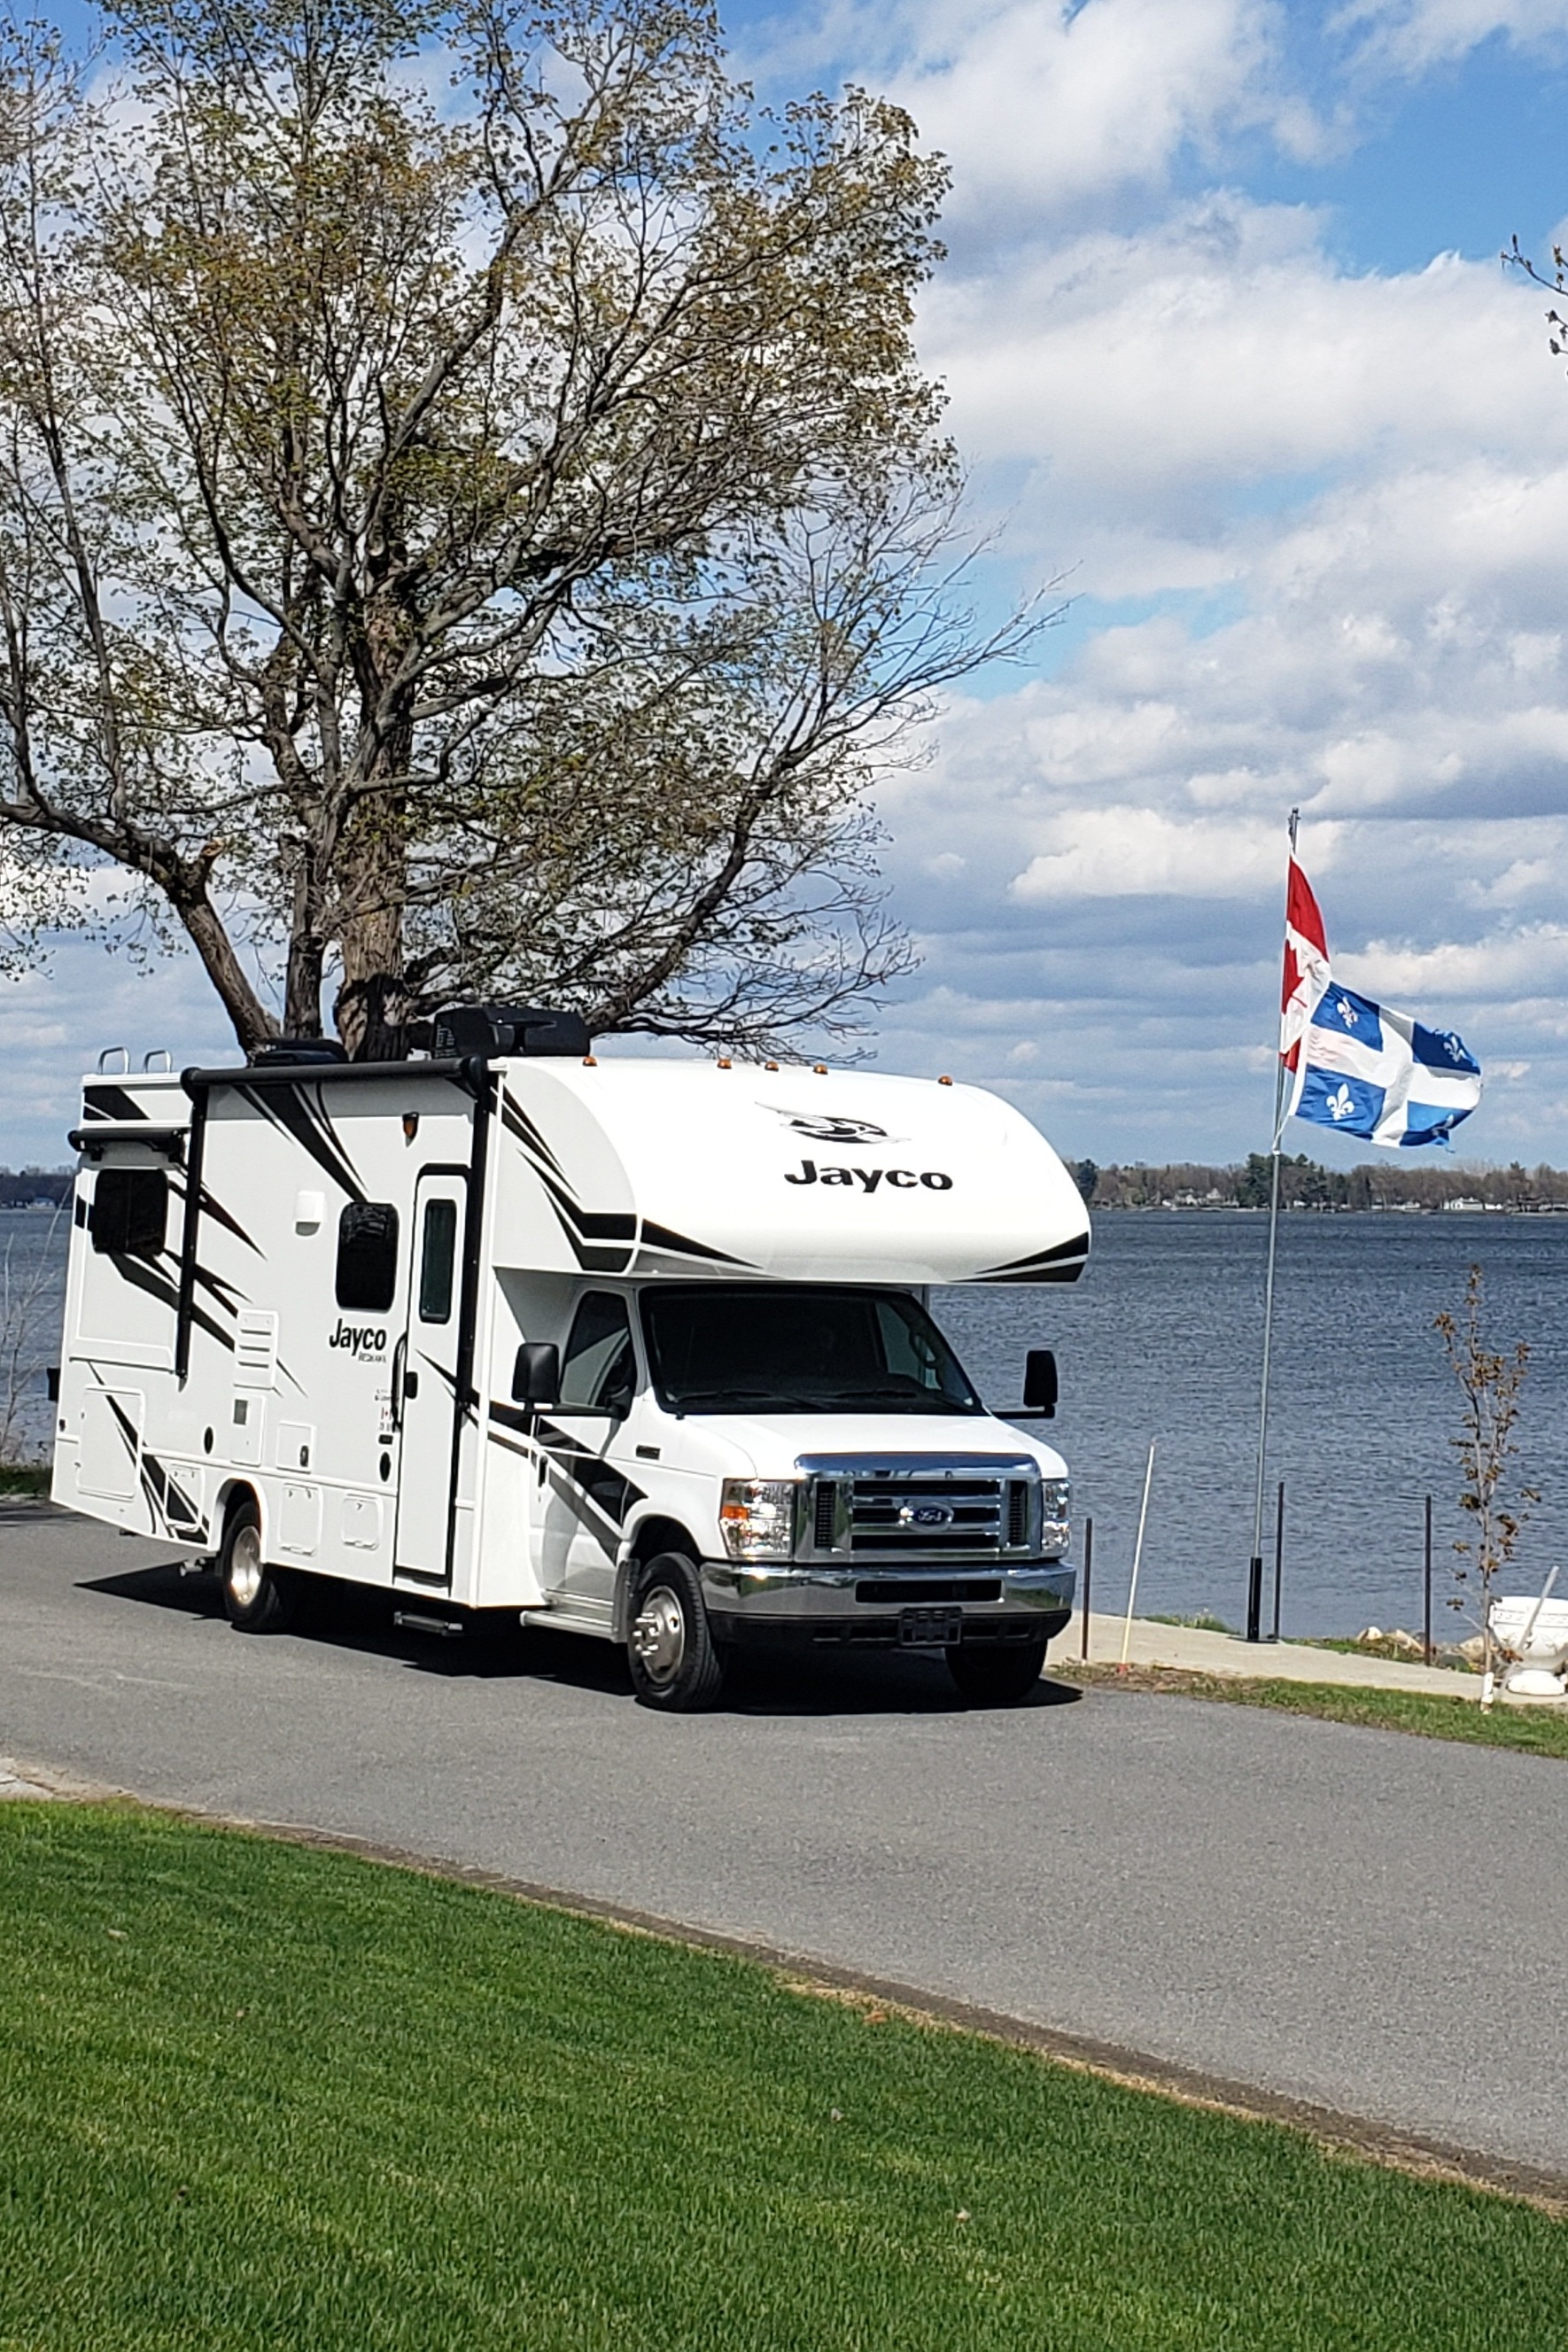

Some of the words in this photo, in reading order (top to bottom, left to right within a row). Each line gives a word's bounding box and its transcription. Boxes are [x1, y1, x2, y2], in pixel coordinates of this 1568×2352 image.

[784, 1160, 953, 1193] Jayco
[329, 1317, 387, 1356] Jayco
[918, 1509, 942, 1522] Ford
